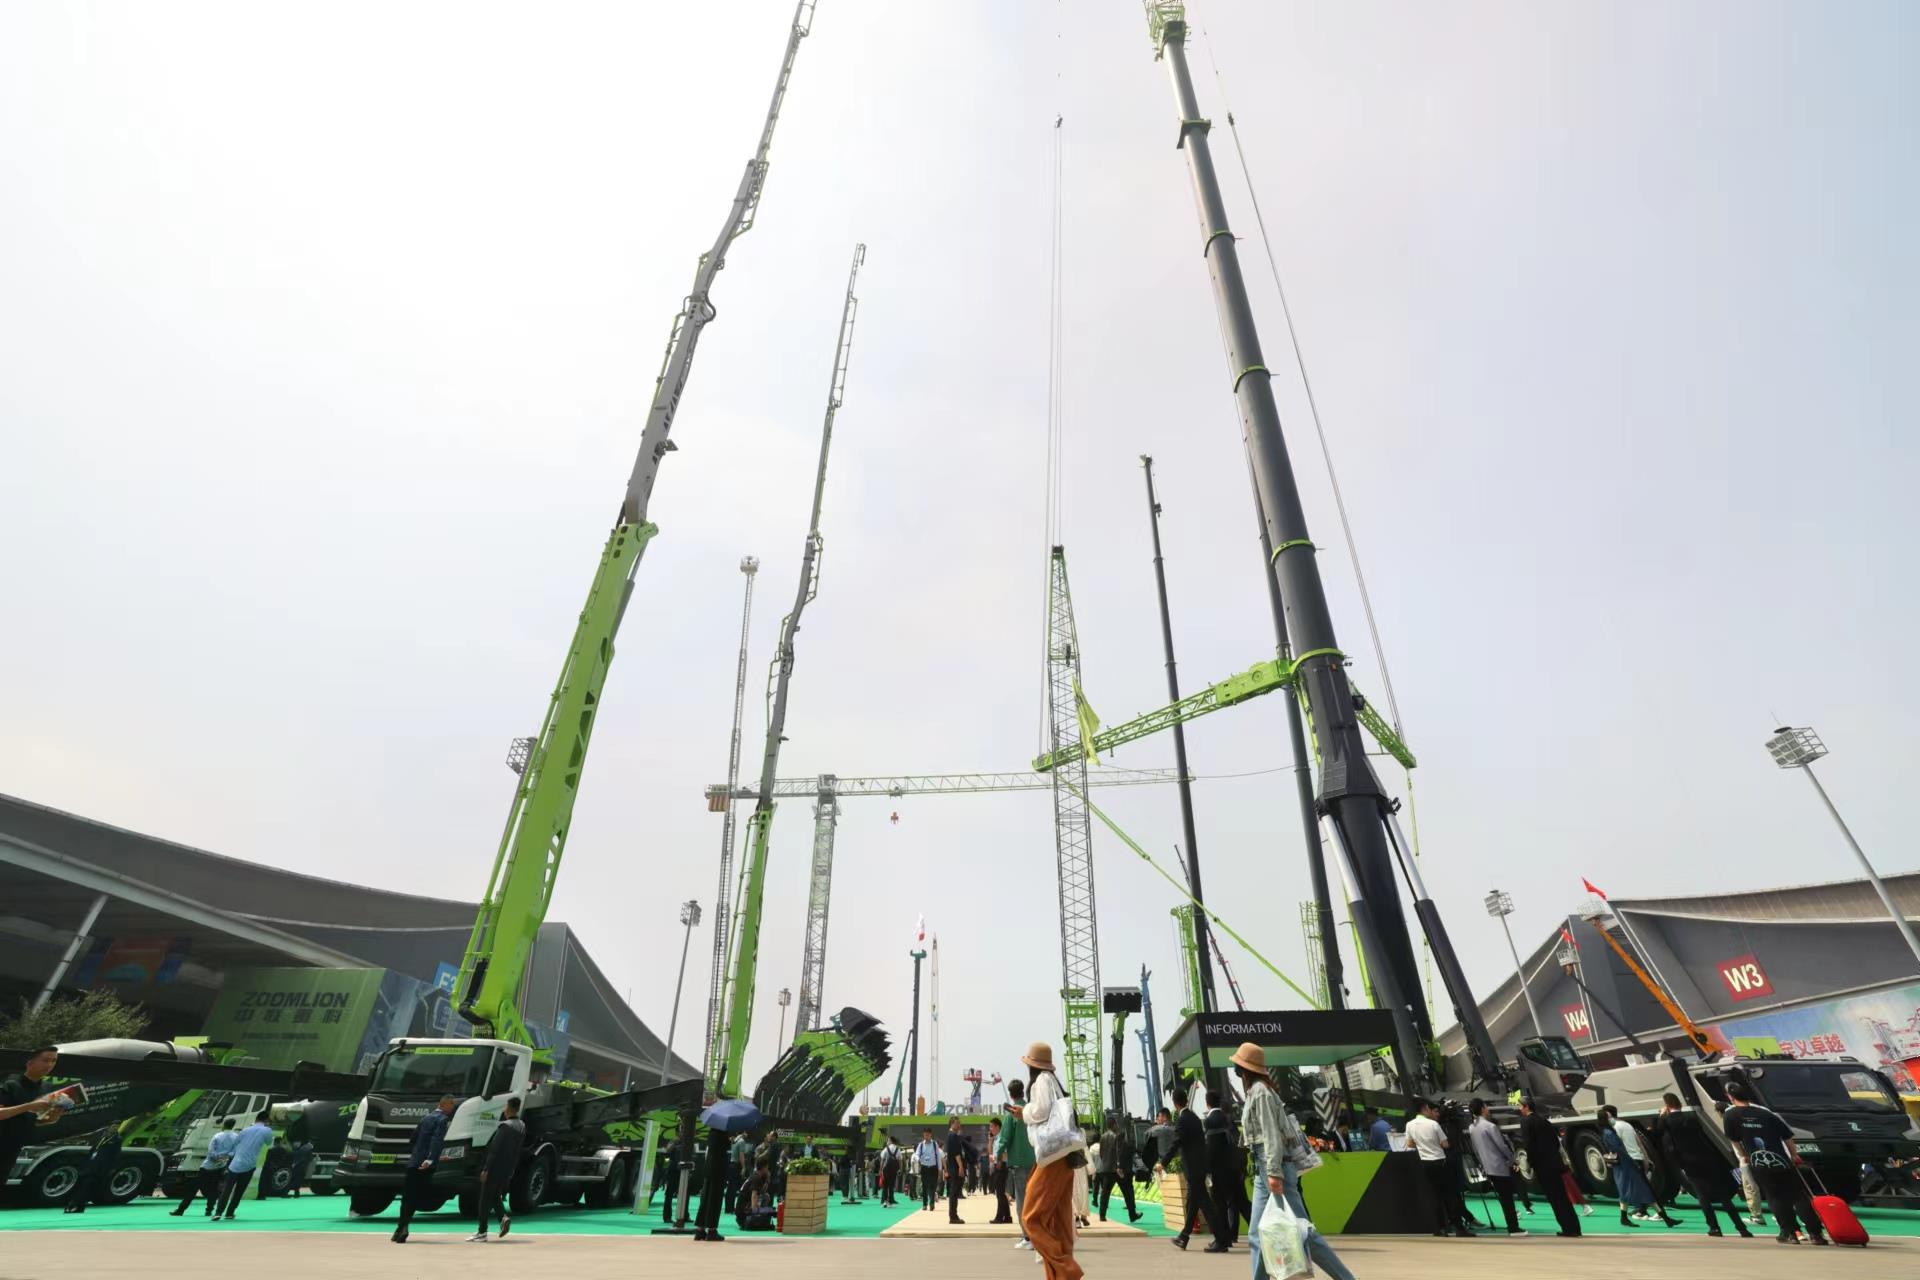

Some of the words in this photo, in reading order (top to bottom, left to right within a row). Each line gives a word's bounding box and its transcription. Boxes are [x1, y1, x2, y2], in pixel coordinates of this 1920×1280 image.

[1724, 963, 1764, 992] W3
[240, 991, 350, 1008] ZOOMLION
[1204, 1022, 1282, 1034] INFORMATION
[1564, 1009, 1590, 1032] W4
[390, 1107, 431, 1116] SCANIA
